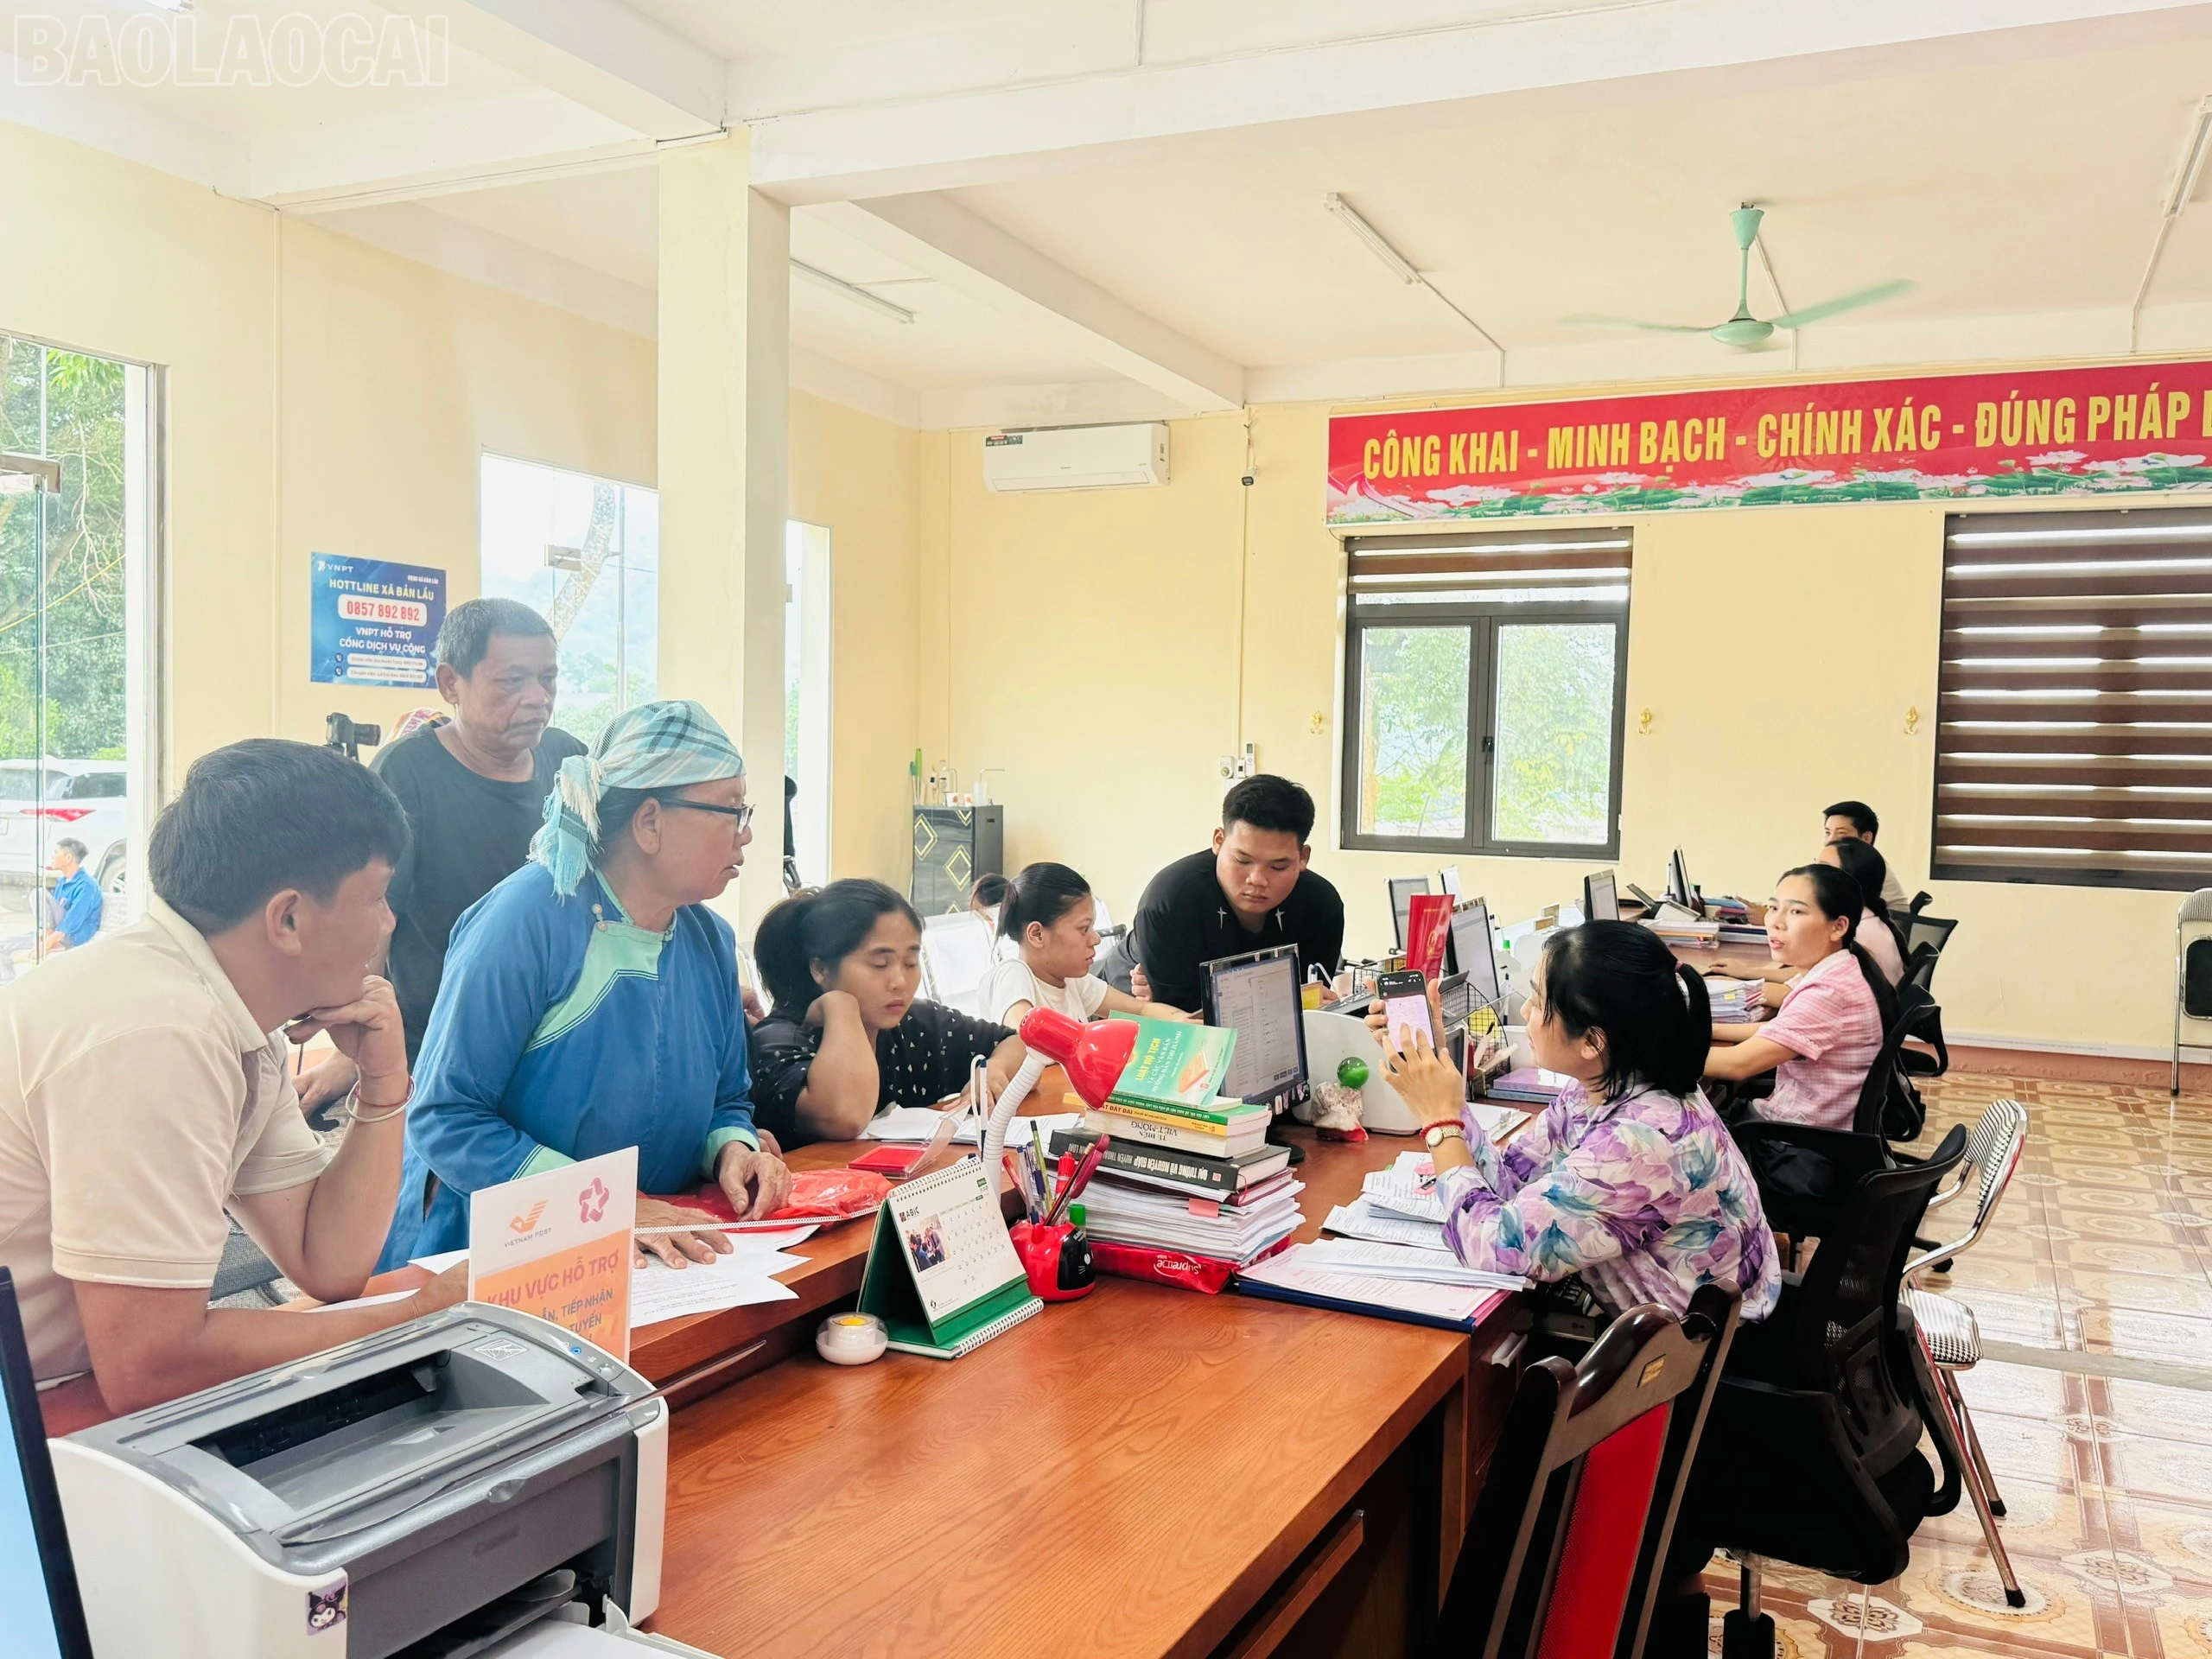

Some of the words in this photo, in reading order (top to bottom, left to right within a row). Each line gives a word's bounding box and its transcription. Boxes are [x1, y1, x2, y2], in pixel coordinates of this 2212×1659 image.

[1363, 429, 1440, 480] CÔNG
[1449, 430, 1519, 474] KHAI
[1547, 423, 1630, 469] MINH
[1639, 416, 1726, 473] BẠCH
[1758, 403, 1863, 459] CHÍNH
[1872, 397, 1942, 453] XÁC
[1974, 390, 2075, 448] ĐÚNG
[2087, 382, 2190, 442] PHÁP
[327, 564, 353, 573] VNPT
[329, 579, 379, 594] HOTTLINE
[396, 584, 415, 598] BẢN
[346, 601, 375, 616] 0857
[378, 604, 397, 619] 892
[401, 607, 419, 621] 892
[355, 626, 379, 636] VNPT
[395, 630, 412, 642] TRỢ
[366, 640, 387, 652] DỊCH
[504, 1234, 533, 1248] VIETNAM
[535, 1227, 552, 1238] POST
[525, 1273, 560, 1300] VỰC
[563, 1256, 585, 1286] HỖ
[589, 1249, 619, 1276] TRỢ
[1156, 1259, 1199, 1274] Supreme
[561, 1296, 583, 1317] TIẾP
[585, 1287, 613, 1309] NHẬN
[569, 1310, 601, 1332] TUYẾN
